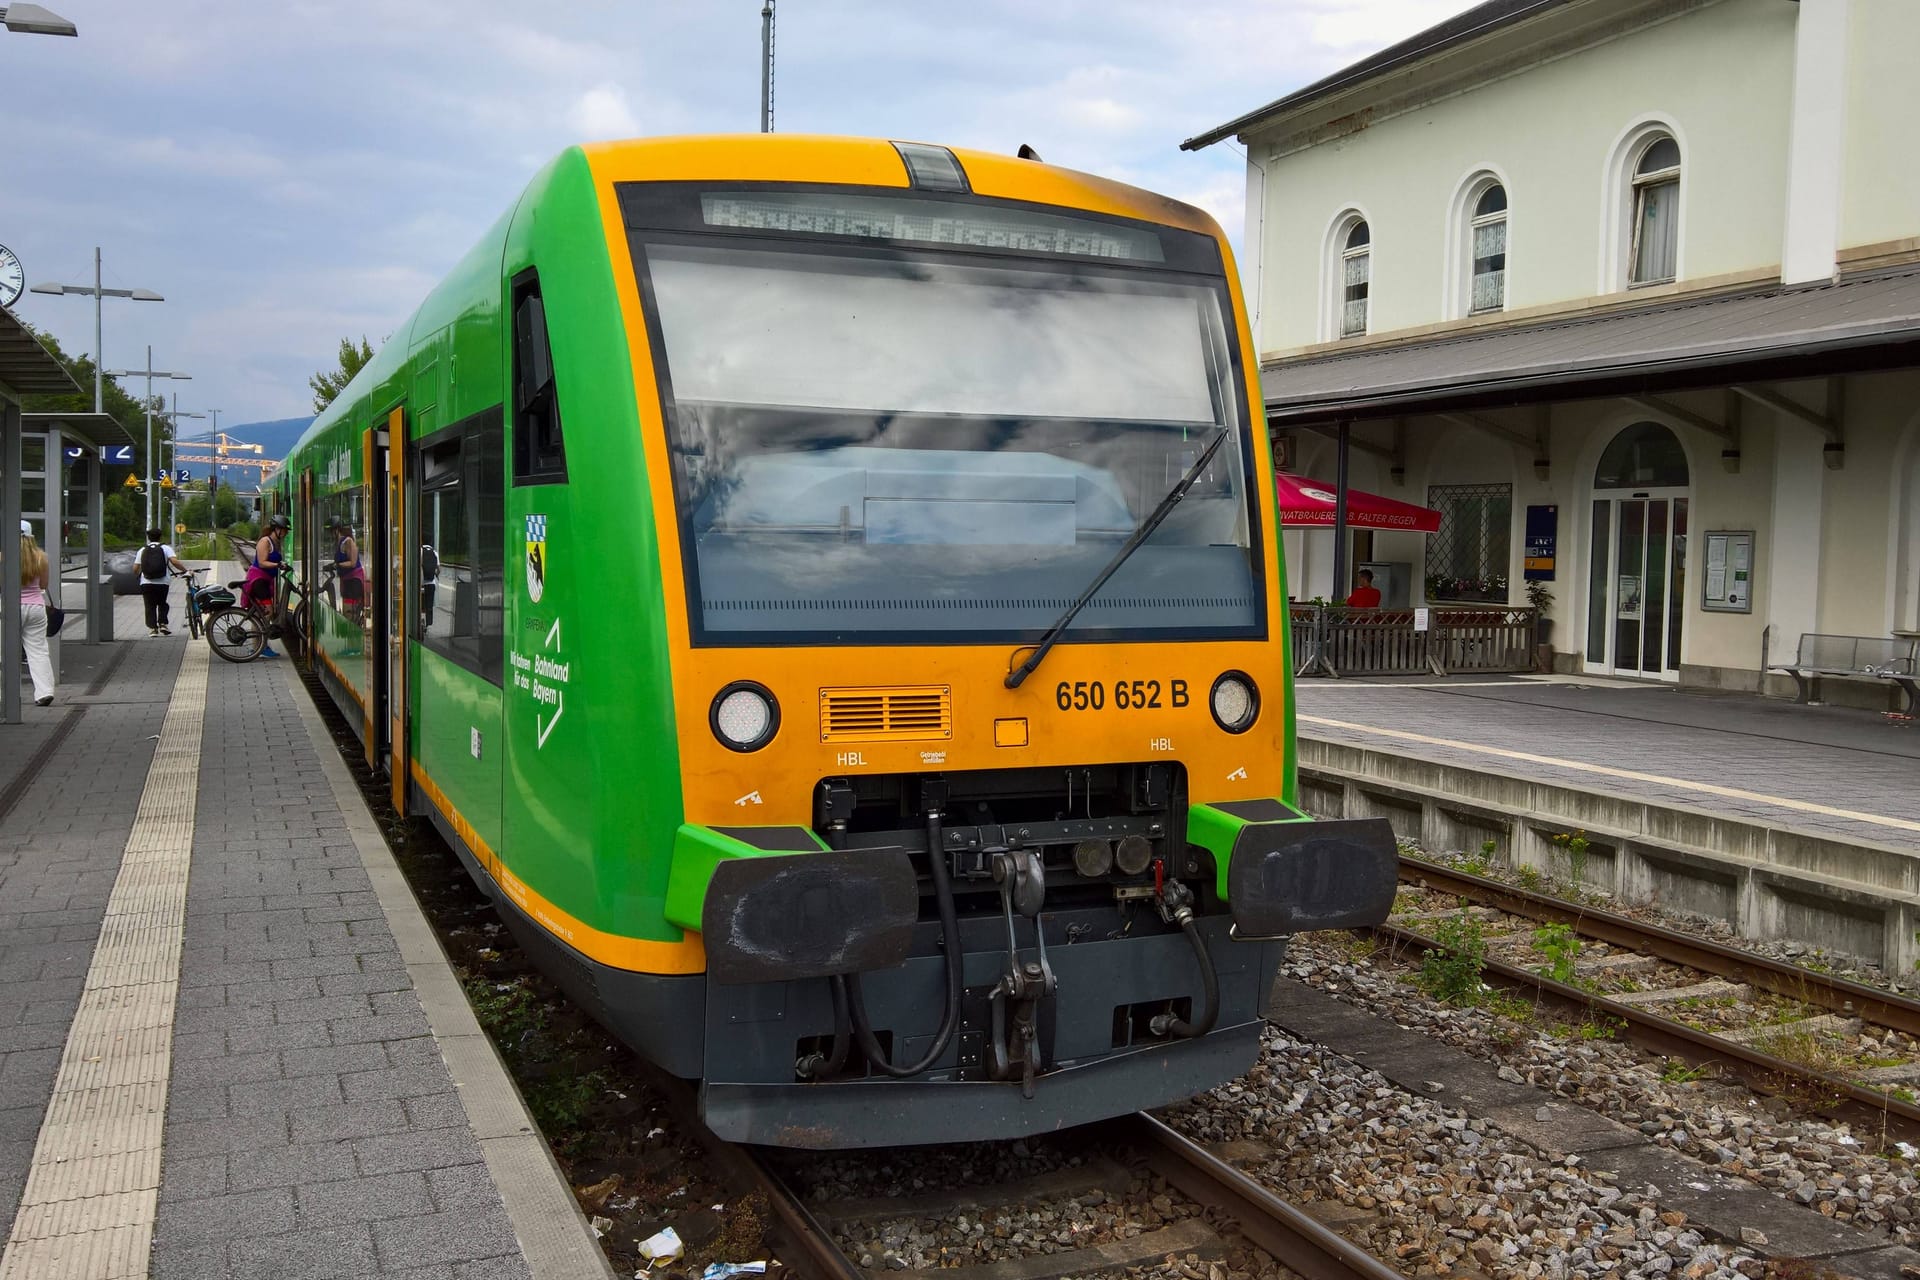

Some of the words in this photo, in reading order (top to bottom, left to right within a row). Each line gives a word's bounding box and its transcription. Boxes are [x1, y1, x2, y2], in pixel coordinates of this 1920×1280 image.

[159, 469, 167, 480] 3
[181, 470, 189, 480] 2
[1357, 512, 1388, 523] FALTER
[1388, 515, 1416, 525] REGEN
[534, 653, 569, 682] Bahnland
[532, 678, 557, 705] Bayern
[1056, 681, 1105, 711] 650
[1115, 680, 1162, 710] 652
[1171, 679, 1190, 708] B
[1150, 738, 1175, 751] HBL
[837, 751, 867, 766] HBL
